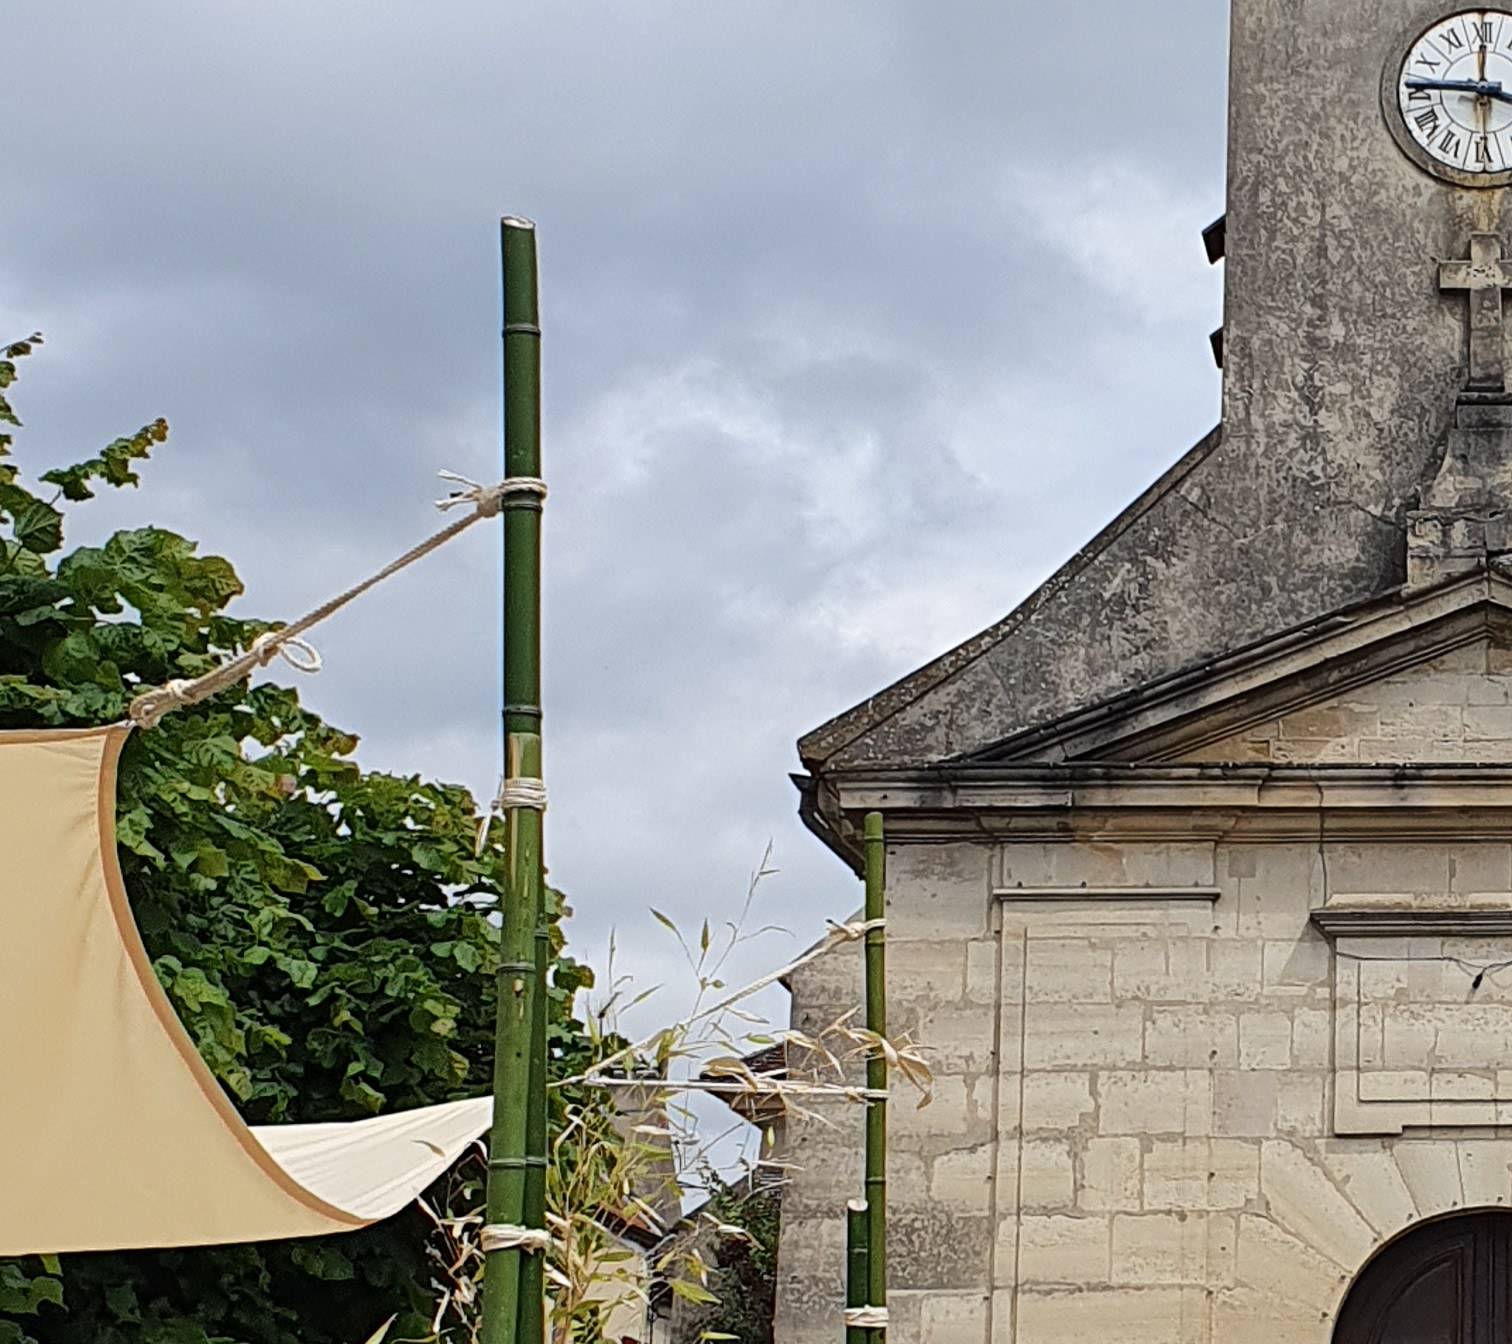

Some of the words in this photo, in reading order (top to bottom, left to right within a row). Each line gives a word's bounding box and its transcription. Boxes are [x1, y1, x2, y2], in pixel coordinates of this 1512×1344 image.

[1439, 28, 1463, 54] XI
[1472, 22, 1492, 44] XII
[1416, 53, 1440, 73] X
[1414, 108, 1440, 139] VIII
[1438, 130, 1460, 159] VII
